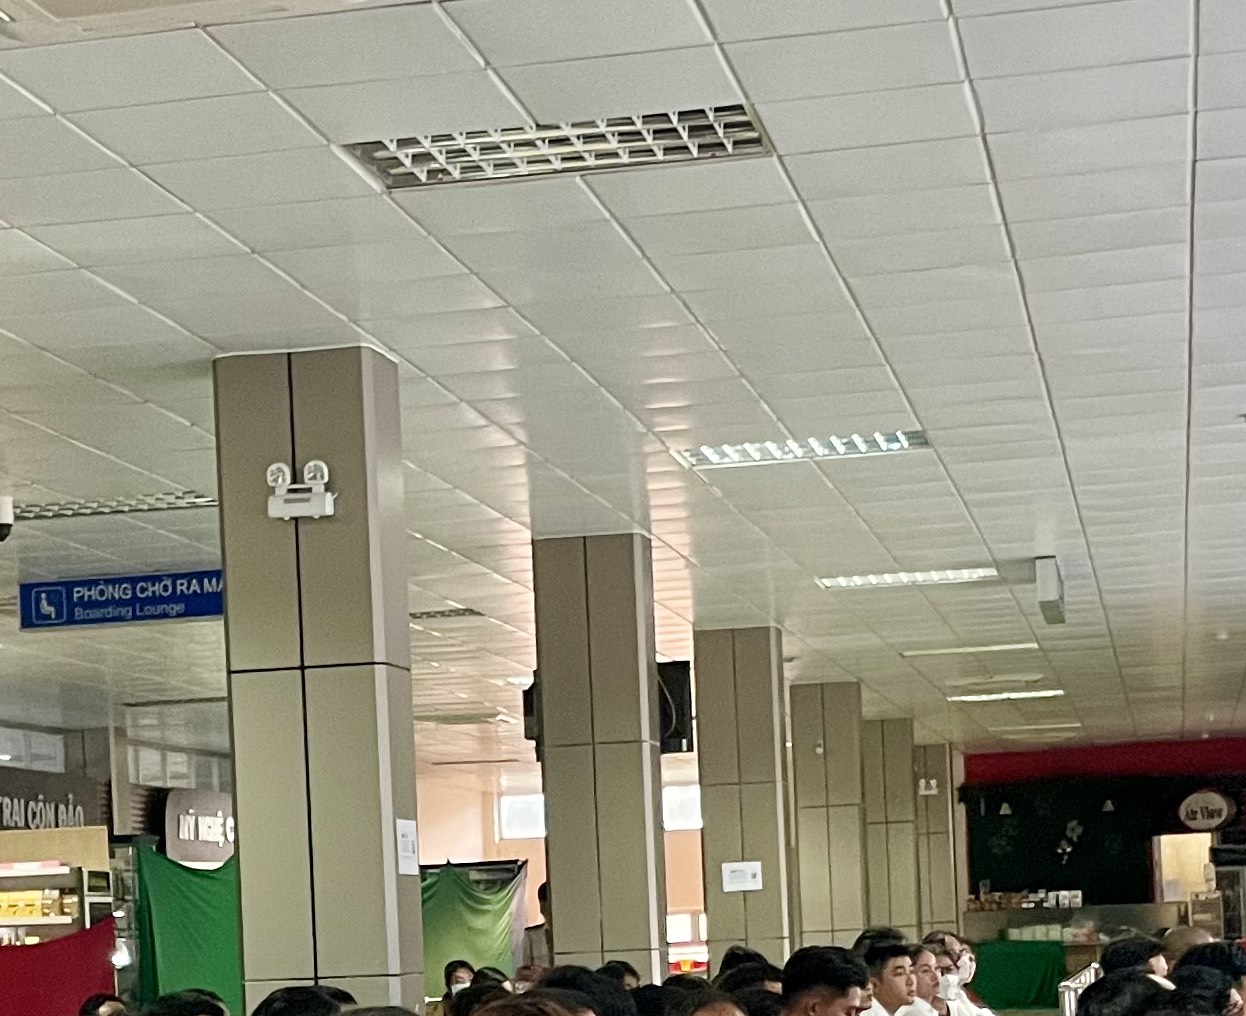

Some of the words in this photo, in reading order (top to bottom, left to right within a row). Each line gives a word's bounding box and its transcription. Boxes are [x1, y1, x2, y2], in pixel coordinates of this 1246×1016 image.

[73, 580, 132, 602] PHÒNG
[176, 578, 201, 595] RA
[74, 605, 132, 621] Boarding
[136, 602, 185, 617] Lounge
